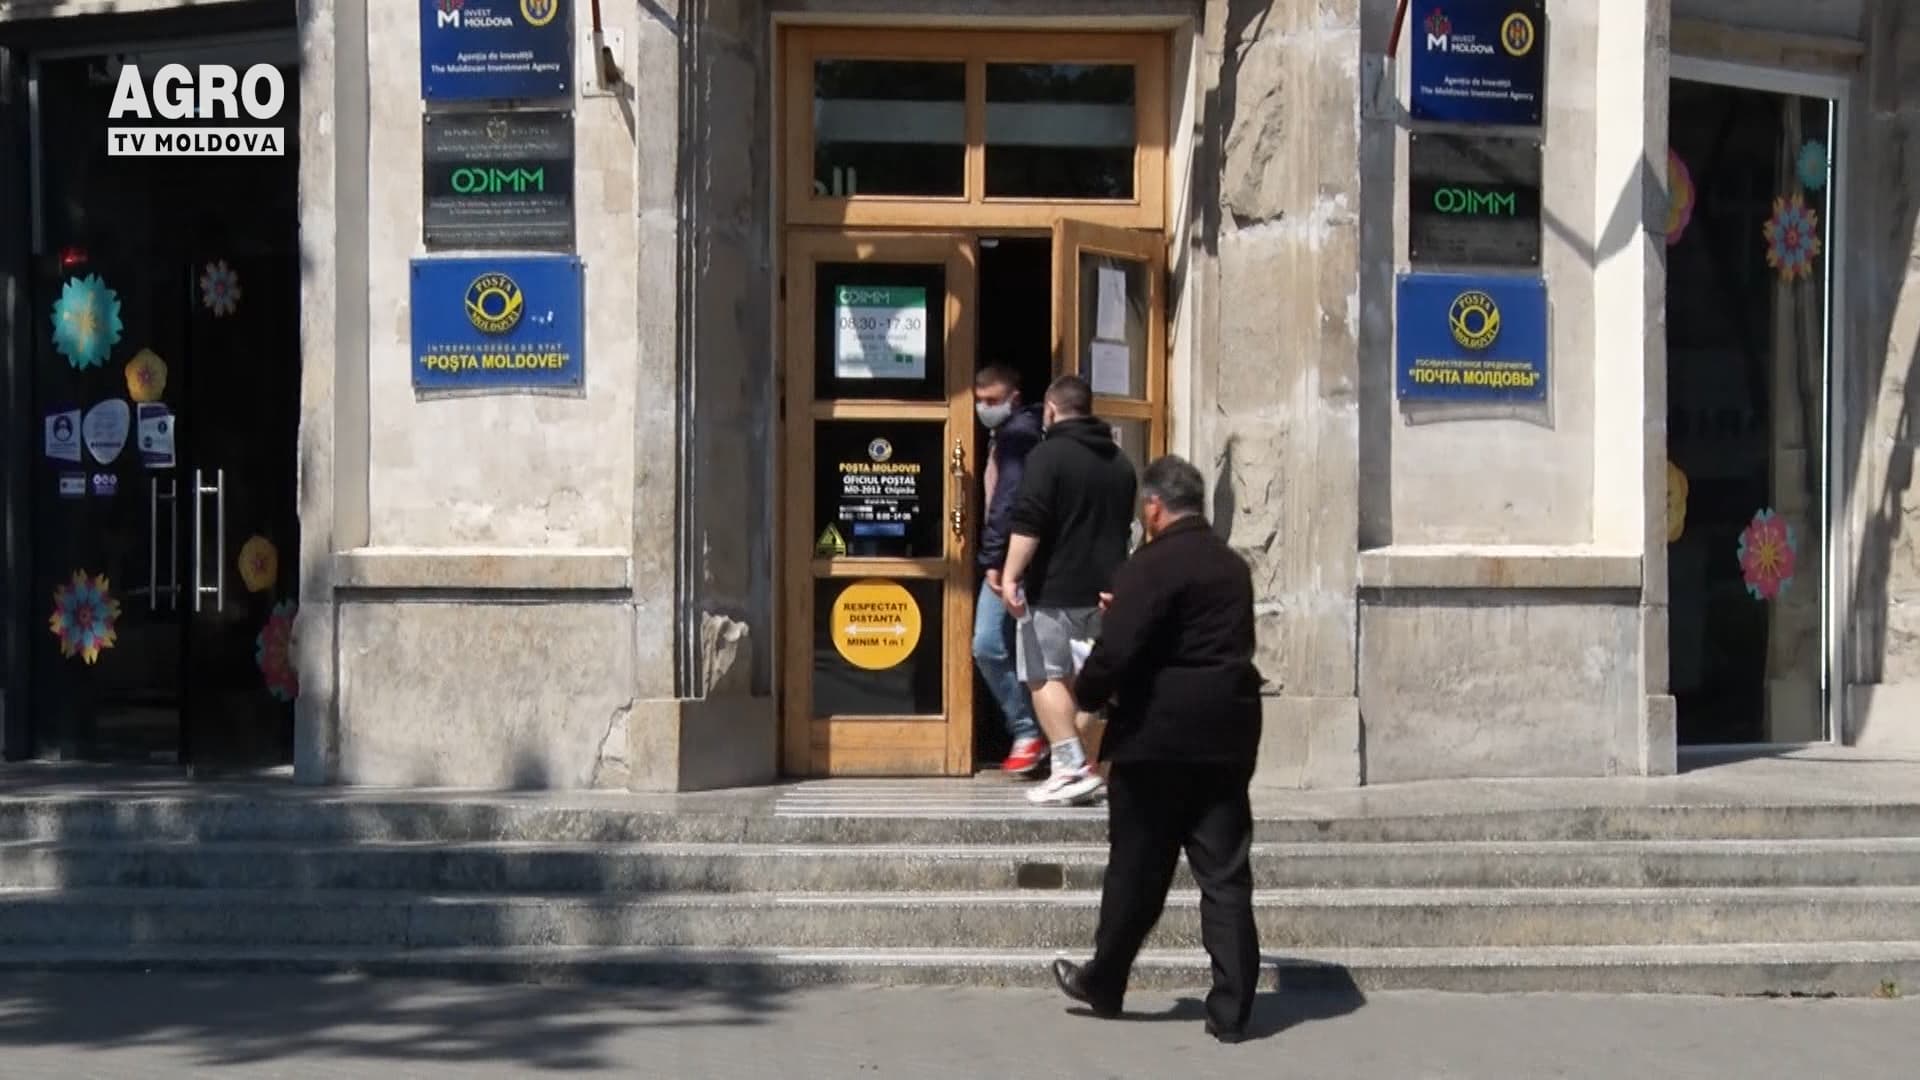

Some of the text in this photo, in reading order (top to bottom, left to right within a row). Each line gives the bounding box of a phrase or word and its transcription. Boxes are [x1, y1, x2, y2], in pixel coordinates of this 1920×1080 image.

[464, 17, 514, 27] MOLDOVA
[1451, 43, 1494, 54] MOLDOVA
[488, 52, 498, 60] de
[431, 63, 560, 73] The Moldovan Investment Agency
[451, 167, 544, 193] ODIMM
[1434, 188, 1516, 216] ODIMM
[538, 343, 562, 351] STAT
[871, 463, 920, 473] MOLDOVEI
[842, 475, 879, 485] OFICIUL
[847, 637, 879, 646] MINIM
